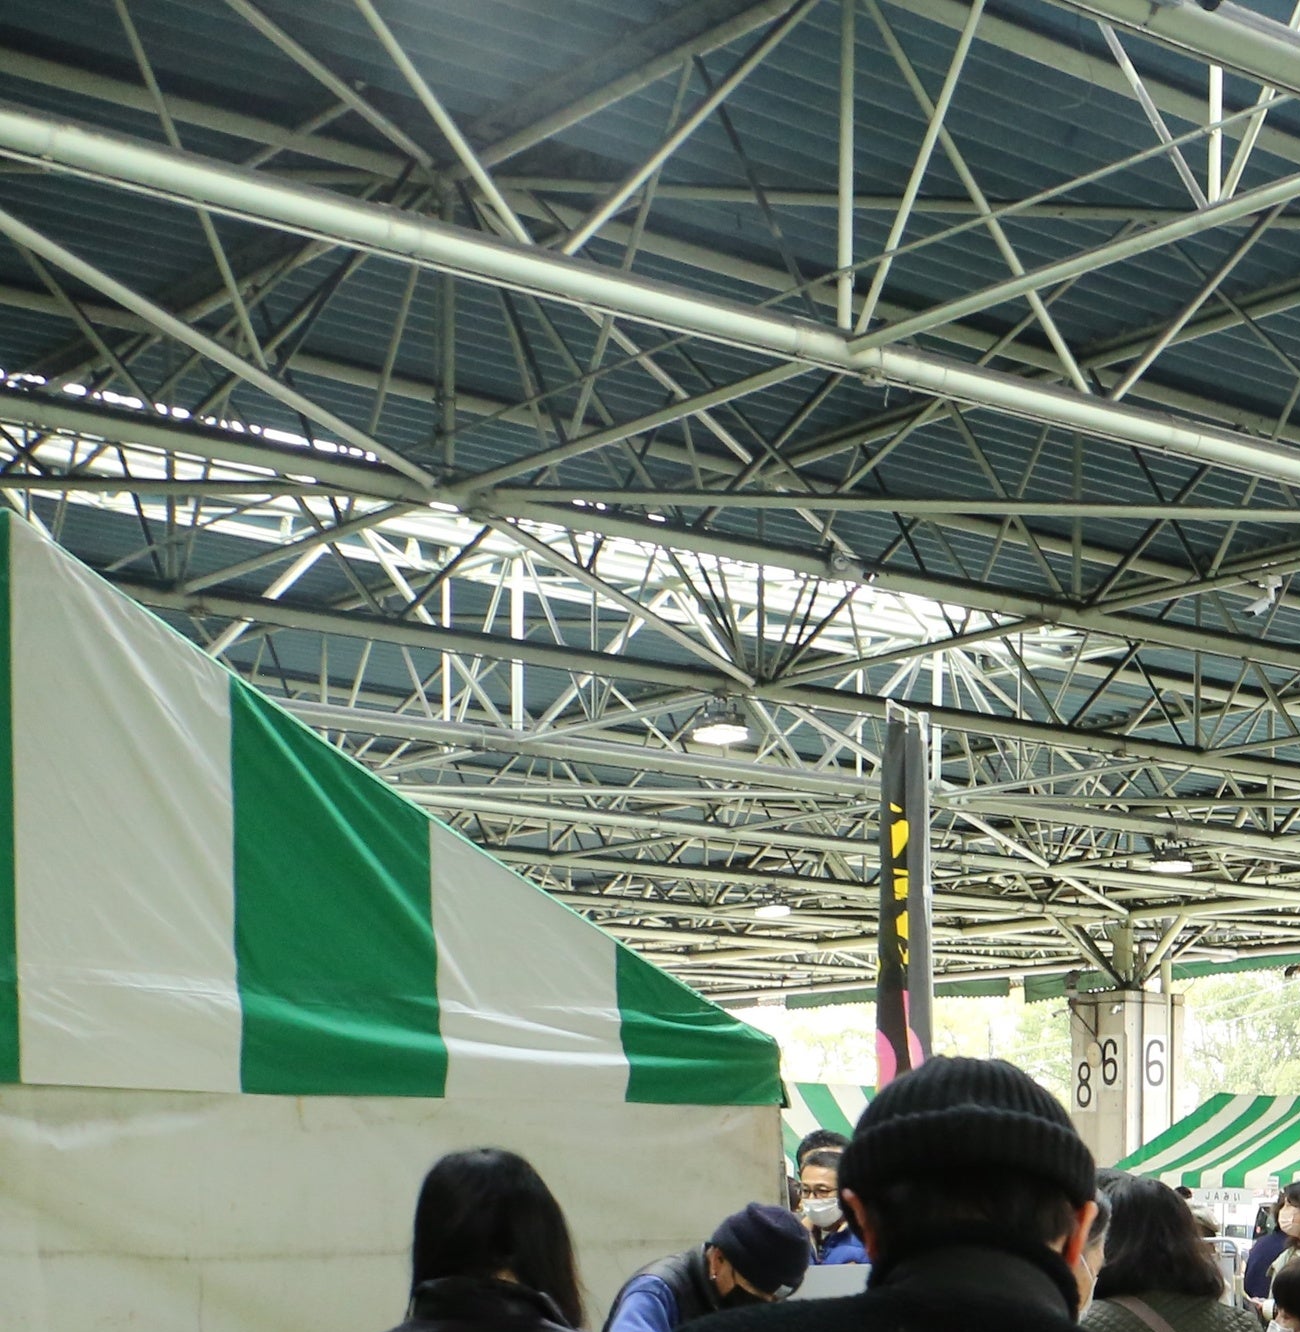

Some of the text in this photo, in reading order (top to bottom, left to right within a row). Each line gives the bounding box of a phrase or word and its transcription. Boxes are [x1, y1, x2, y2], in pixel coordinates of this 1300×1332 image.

[1076, 1061, 1092, 1108] 8
[1102, 1038, 1118, 1086] 6
[1145, 1039, 1165, 1087] 6
